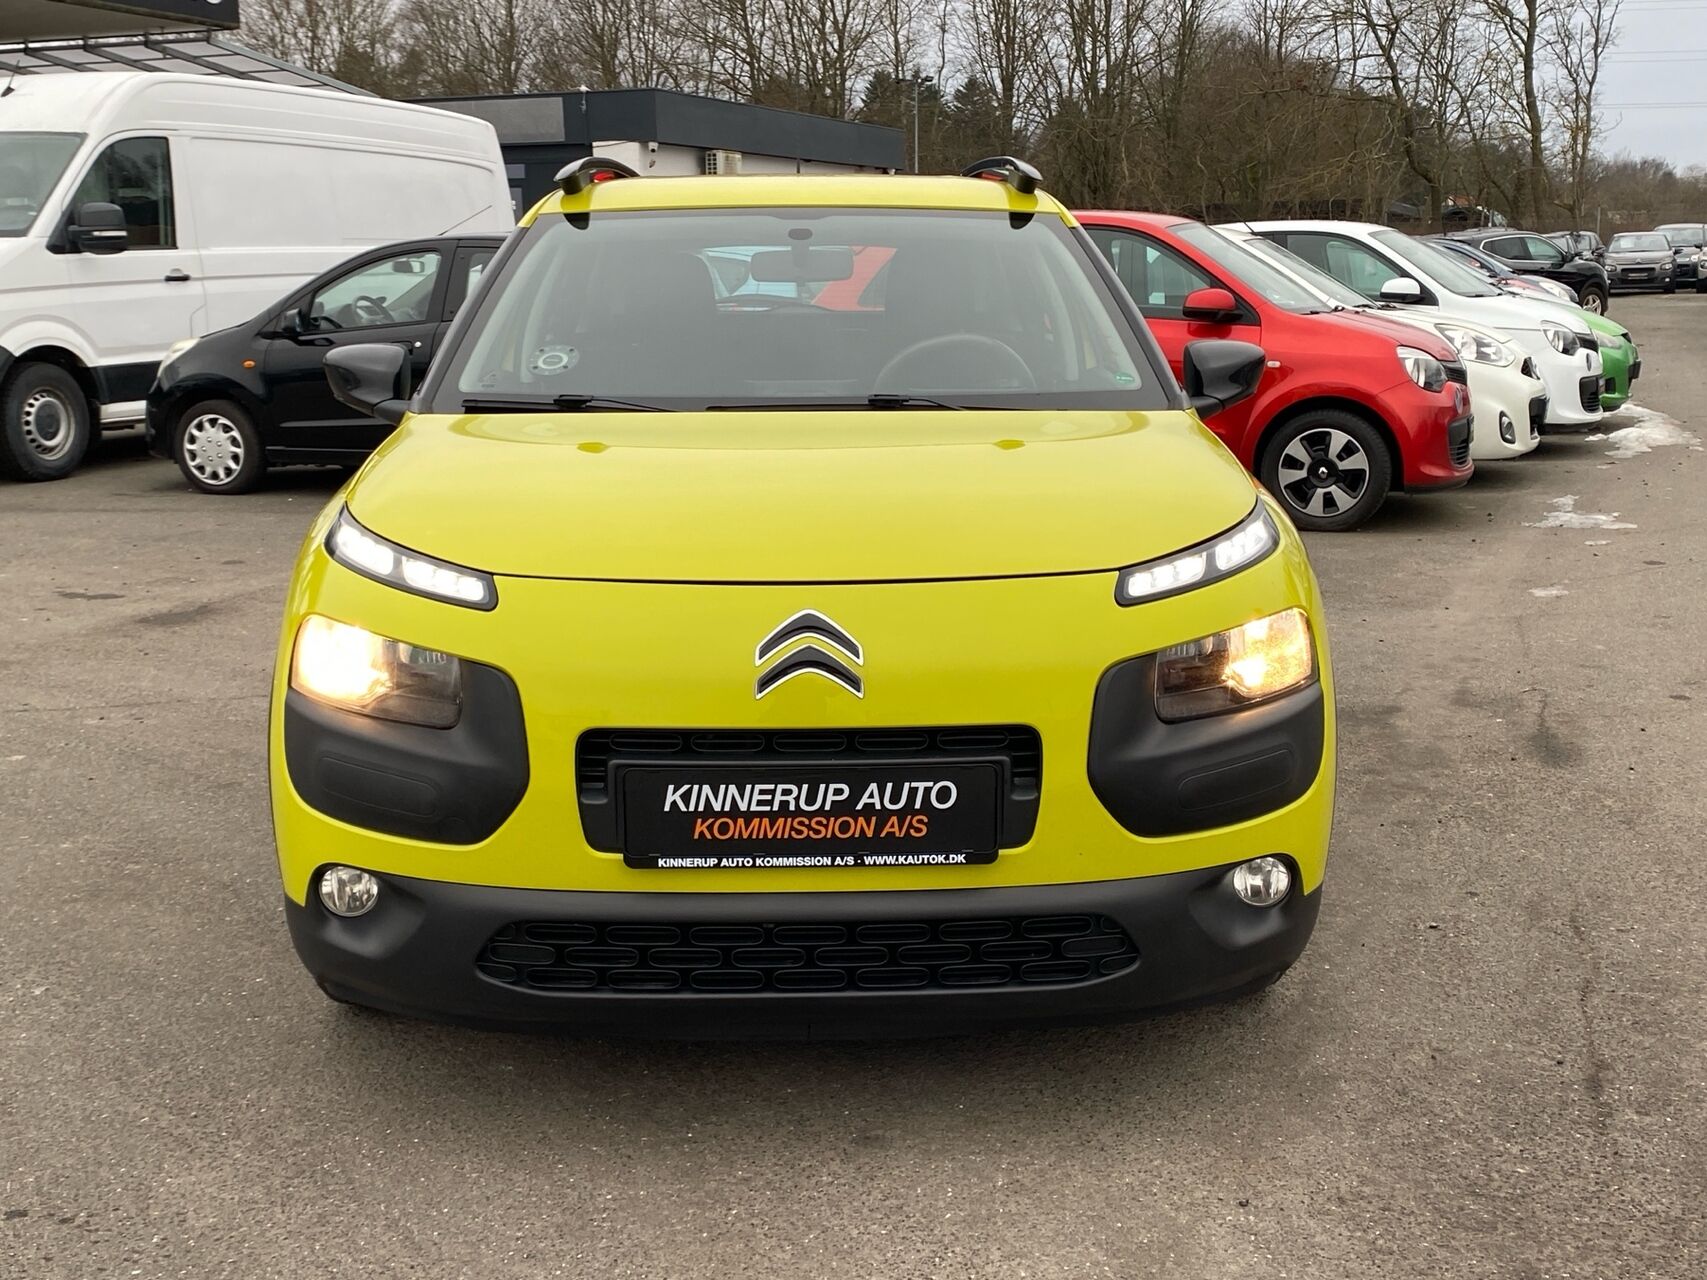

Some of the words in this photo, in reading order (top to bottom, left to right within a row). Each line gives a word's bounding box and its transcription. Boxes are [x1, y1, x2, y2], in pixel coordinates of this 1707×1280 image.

[663, 783, 850, 812] KINNERUP
[855, 780, 958, 811] AUTO
[693, 816, 876, 840] KOMMISSION
[878, 814, 929, 838] A/S
[658, 857, 718, 868] KINNERUP
[719, 857, 754, 867] AUTO
[755, 856, 831, 867] KOMMISSION
[833, 856, 855, 866] A/S
[863, 854, 966, 866] WWW.KAUTOK.DK
